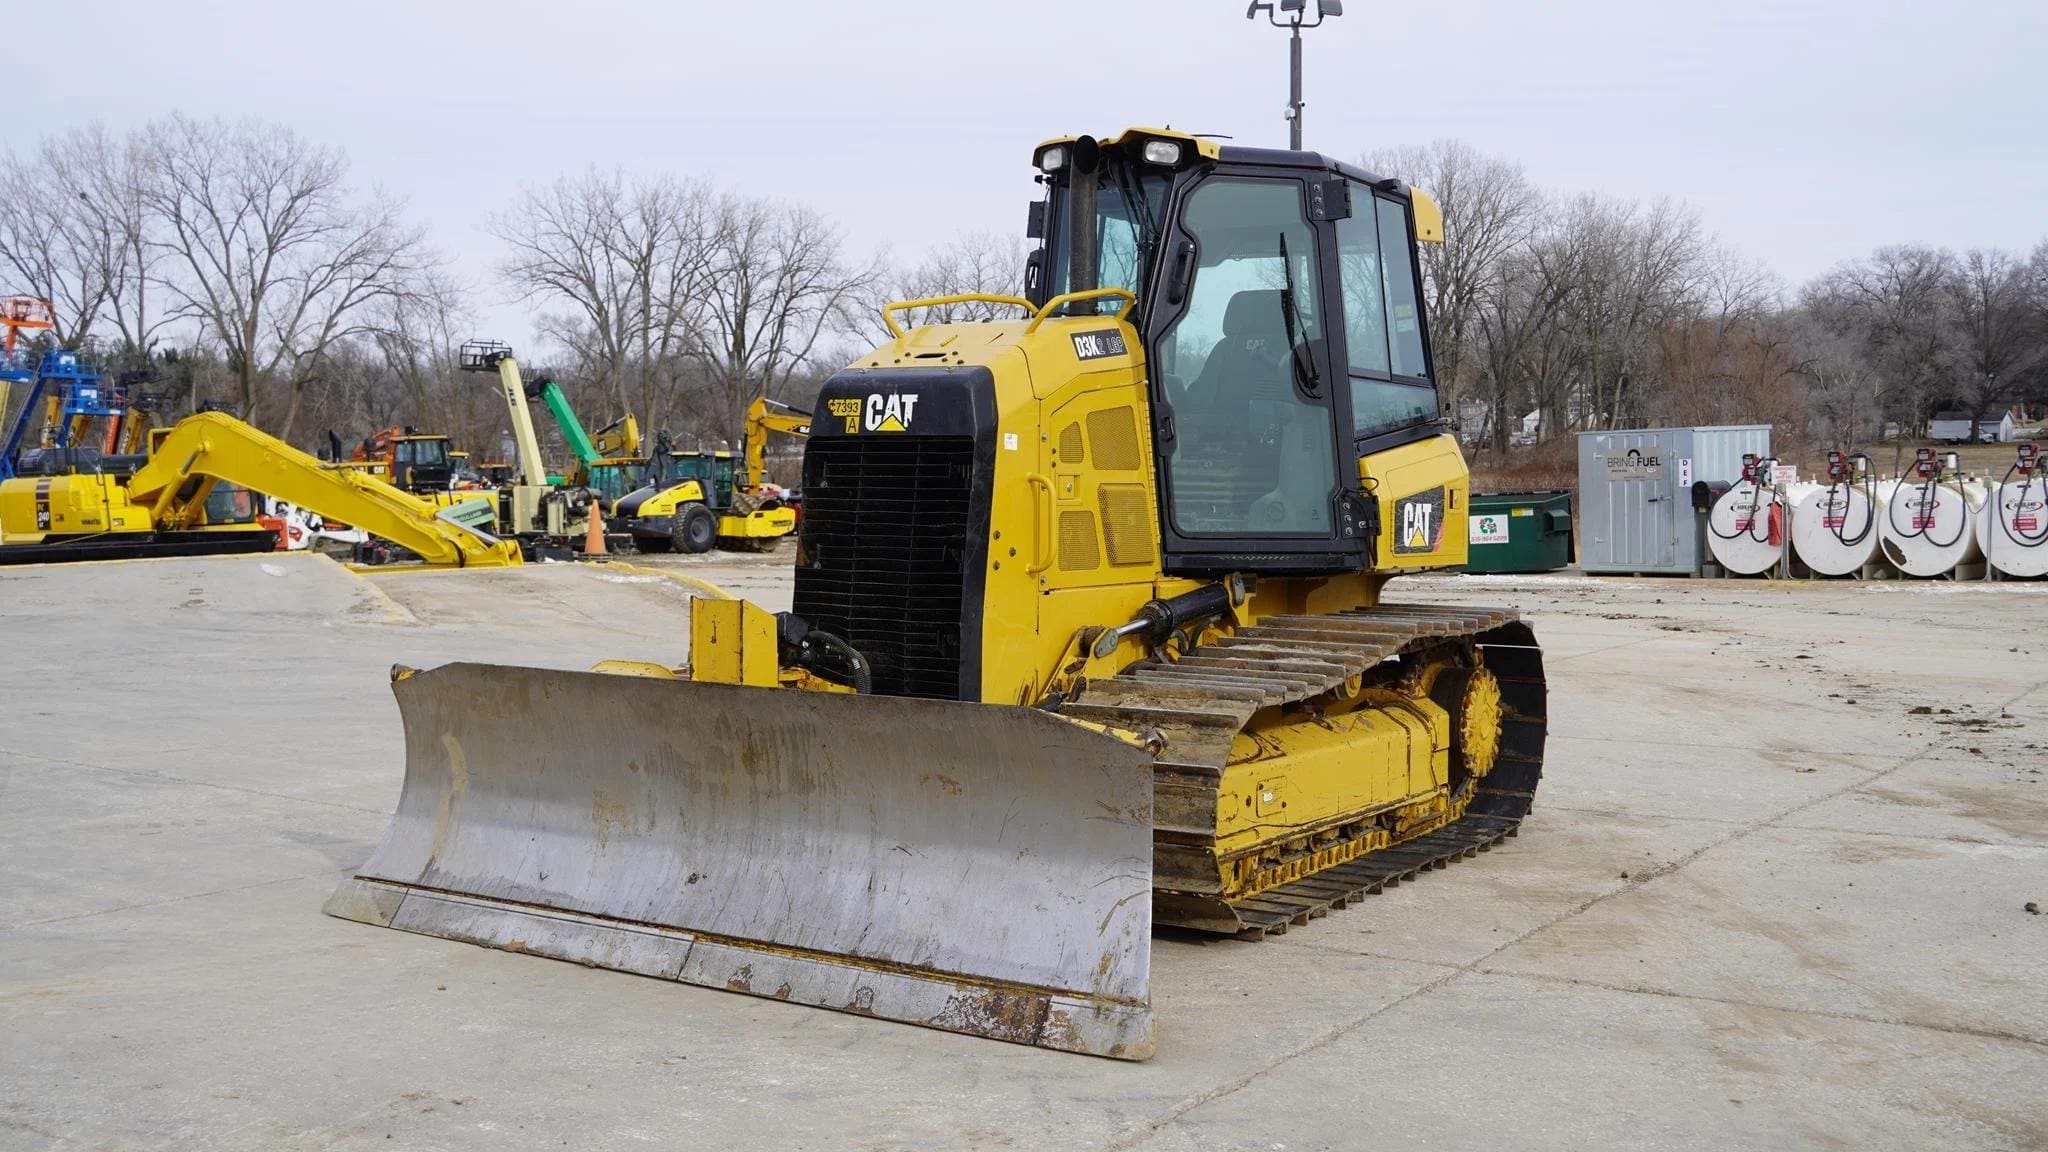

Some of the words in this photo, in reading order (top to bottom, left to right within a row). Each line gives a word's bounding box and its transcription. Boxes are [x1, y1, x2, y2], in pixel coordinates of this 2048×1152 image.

[865, 393, 919, 432] CAT
[847, 417, 857, 432] A
[1607, 457, 1635, 467] BRING
[1636, 456, 1662, 467] FUEL
[38, 511, 50, 522] 240
[1403, 502, 1432, 547] CAT
